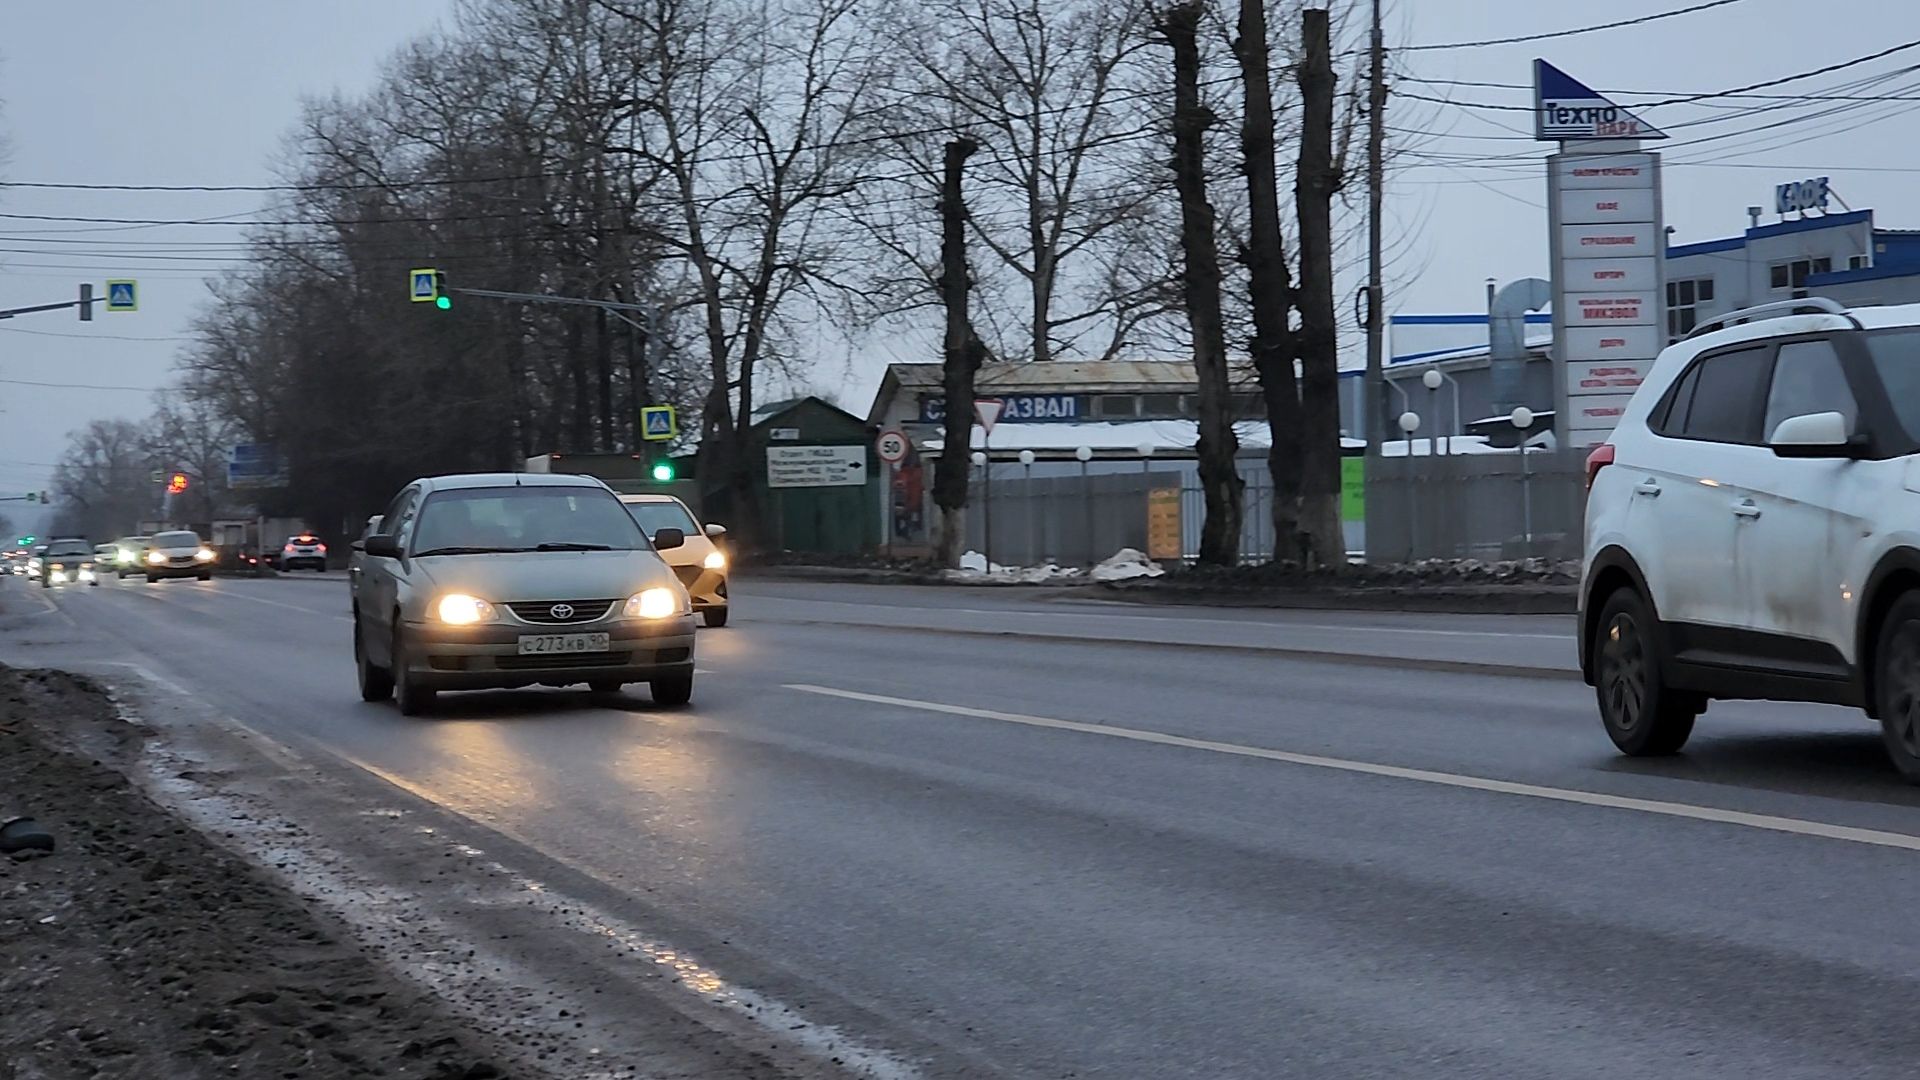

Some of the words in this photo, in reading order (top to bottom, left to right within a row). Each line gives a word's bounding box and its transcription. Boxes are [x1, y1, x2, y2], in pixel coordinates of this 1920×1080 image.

[1546, 102, 1617, 124] Техно
[1597, 120, 1638, 136] ПАРК
[1776, 176, 1828, 214] КАФЕ
[883, 440, 901, 454] 50
